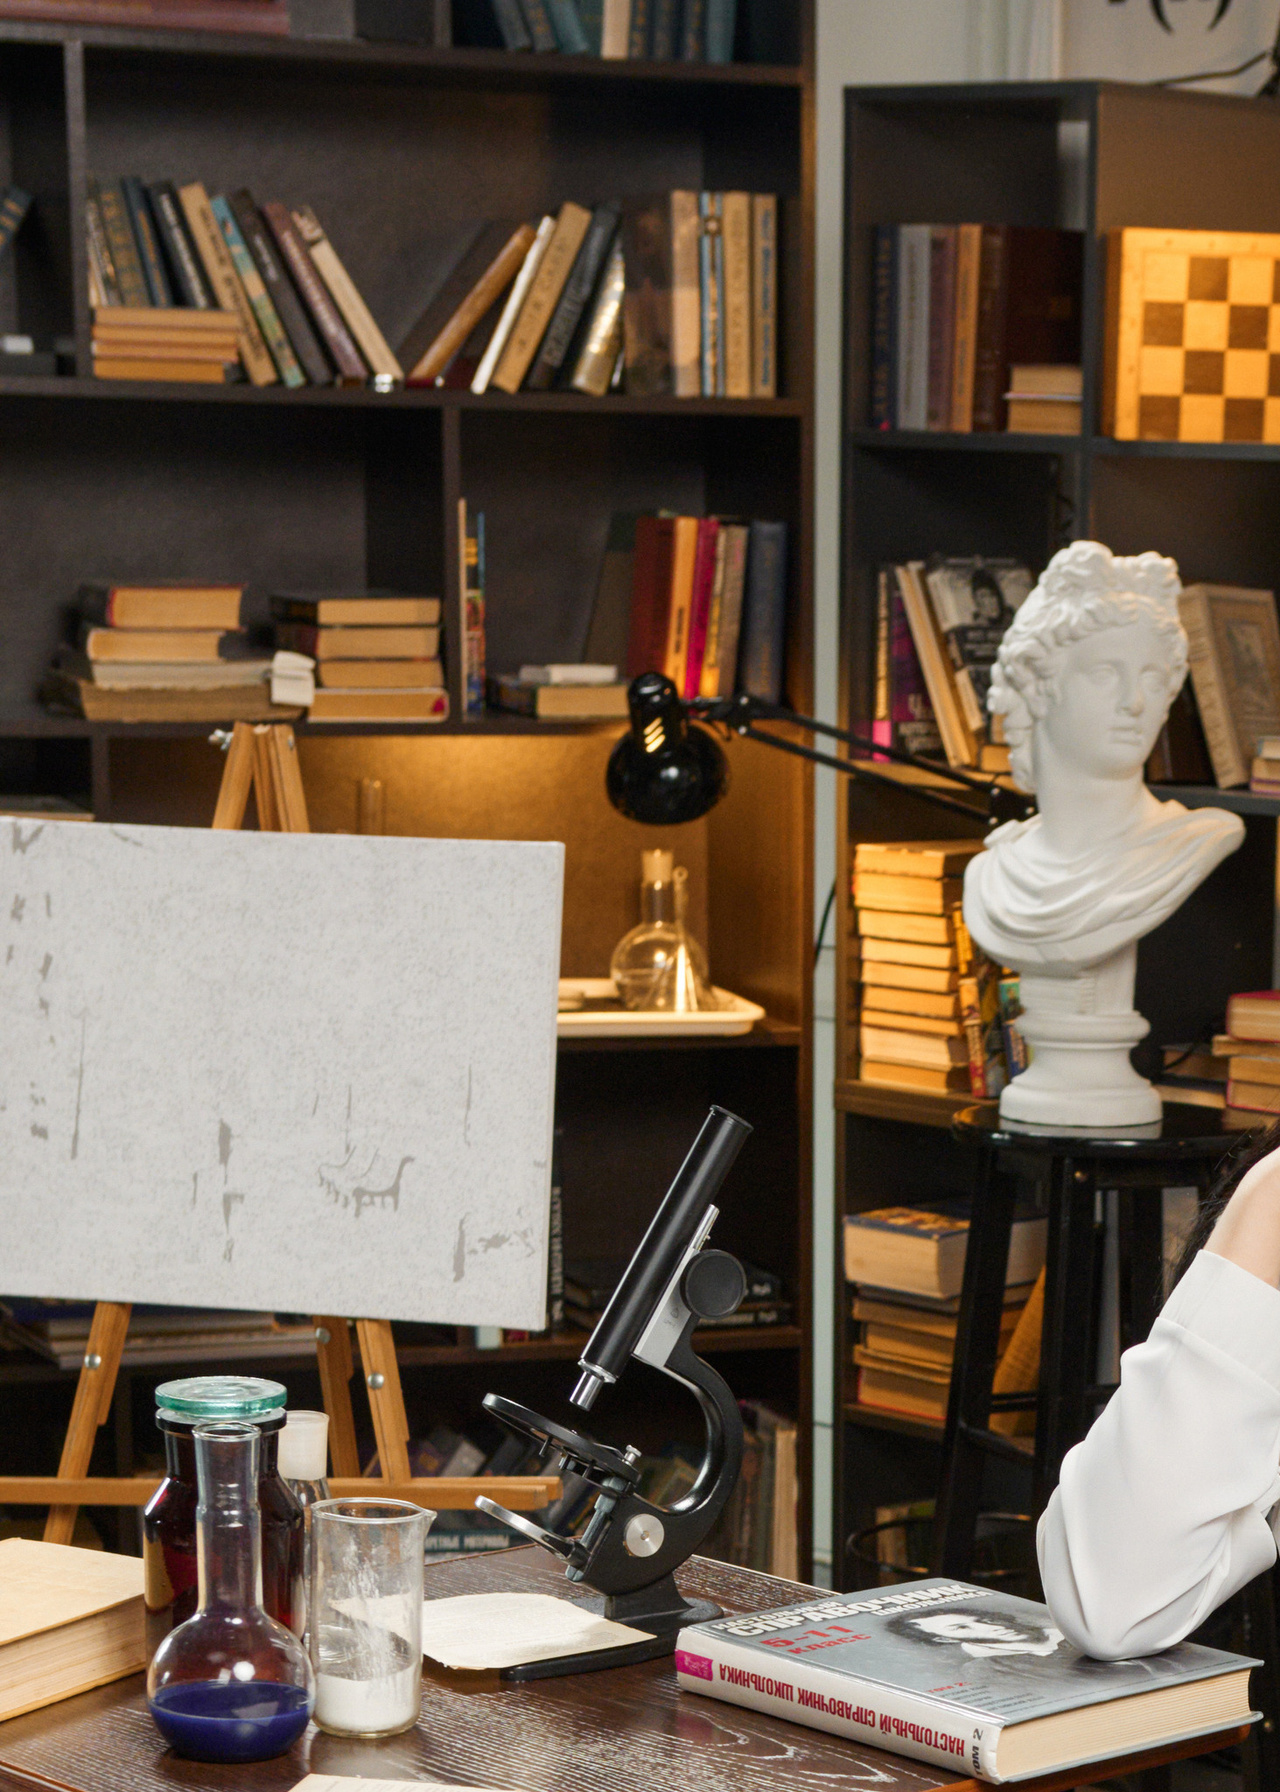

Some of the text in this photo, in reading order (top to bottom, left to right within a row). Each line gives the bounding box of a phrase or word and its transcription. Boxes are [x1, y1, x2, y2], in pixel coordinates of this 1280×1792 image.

[726, 1583, 979, 1638] СПРАВОЧНИК
[760, 1624, 855, 1649] 5-11
[787, 1633, 872, 1655] класс
[719, 1663, 965, 1758] НАСТОЛЬНЫЙ СПРАВОЧНИК ШКОЛЬНИКА
[970, 1727, 984, 1776] ТОМ 2
